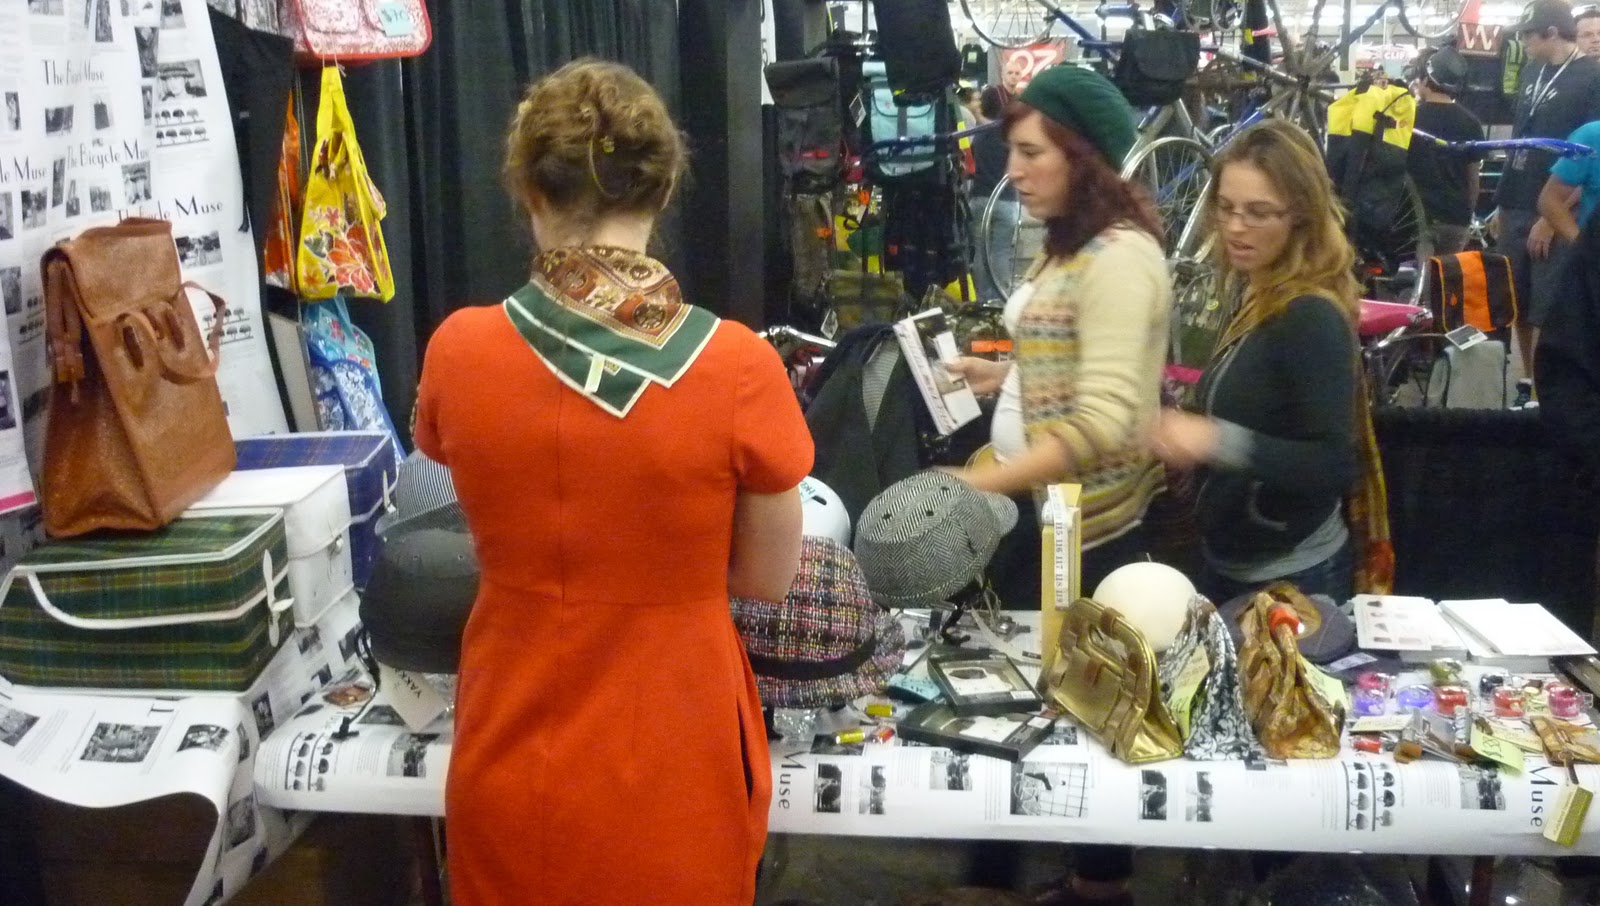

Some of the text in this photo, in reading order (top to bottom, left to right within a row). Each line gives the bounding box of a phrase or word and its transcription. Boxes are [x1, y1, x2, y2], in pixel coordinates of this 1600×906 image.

[41, 58, 63, 86] The
[13, 155, 47, 181] Muse
[79, 141, 120, 168] Bicycle
[174, 194, 224, 217] Muse
[778, 751, 807, 809] Muse
[1529, 766, 1558, 827] Muse
